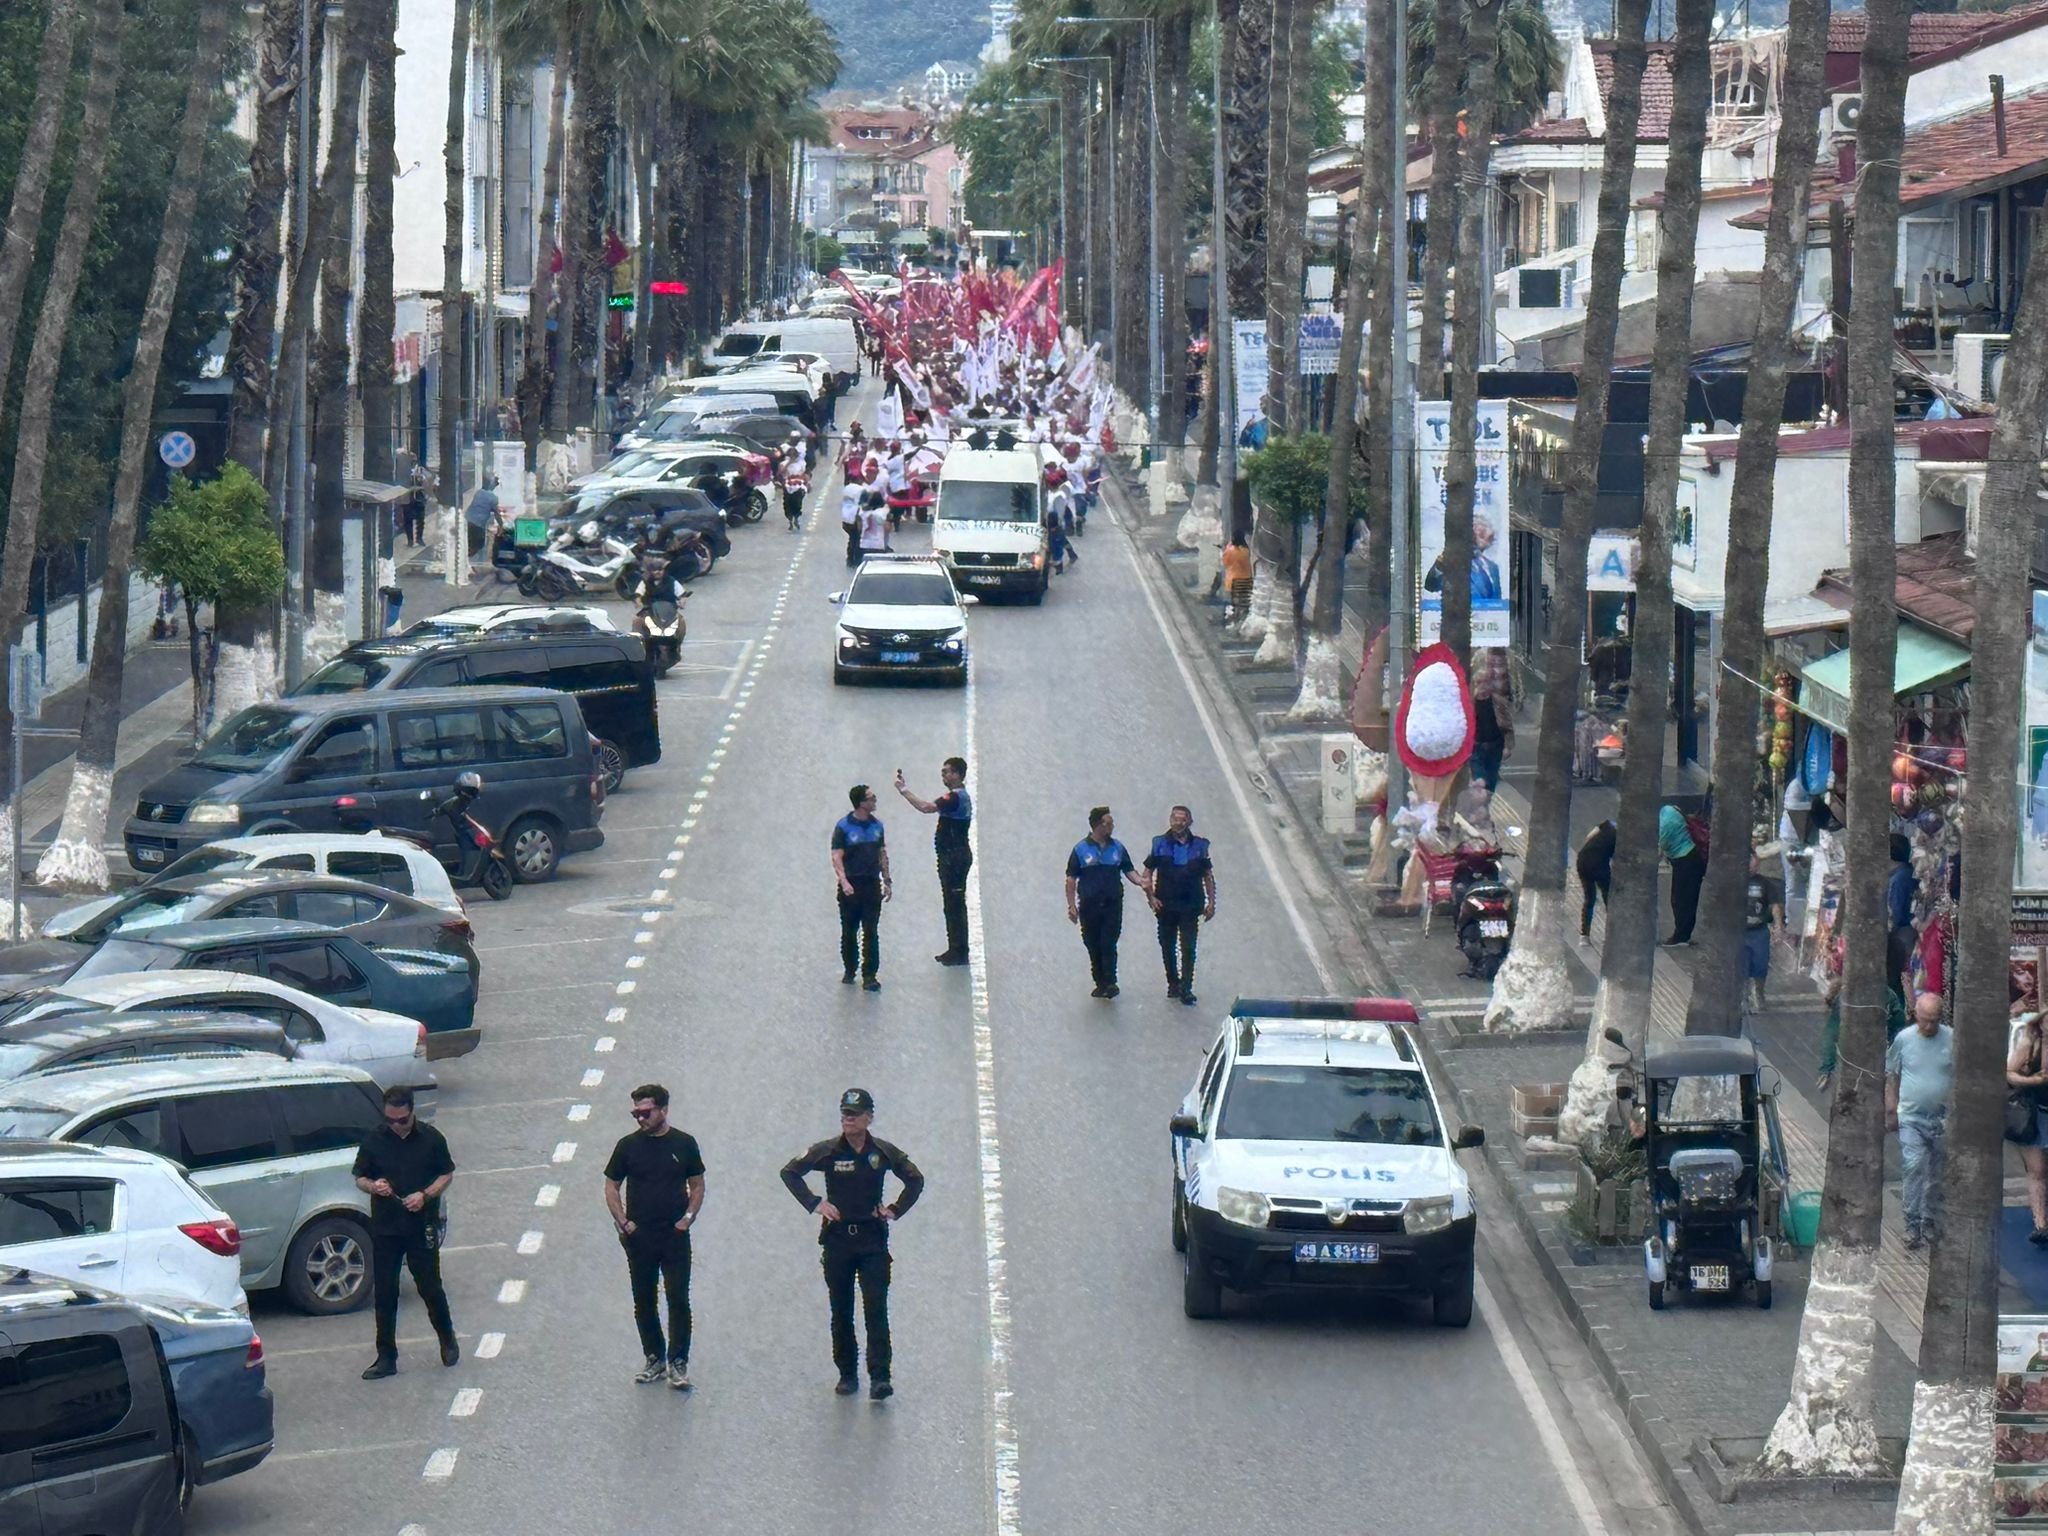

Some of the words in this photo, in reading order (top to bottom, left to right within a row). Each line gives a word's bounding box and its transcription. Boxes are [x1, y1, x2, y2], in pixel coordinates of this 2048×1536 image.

[1600, 549, 1625, 577] A
[1283, 1166, 1396, 1182] POLİS
[1321, 1244, 1331, 1257] A
